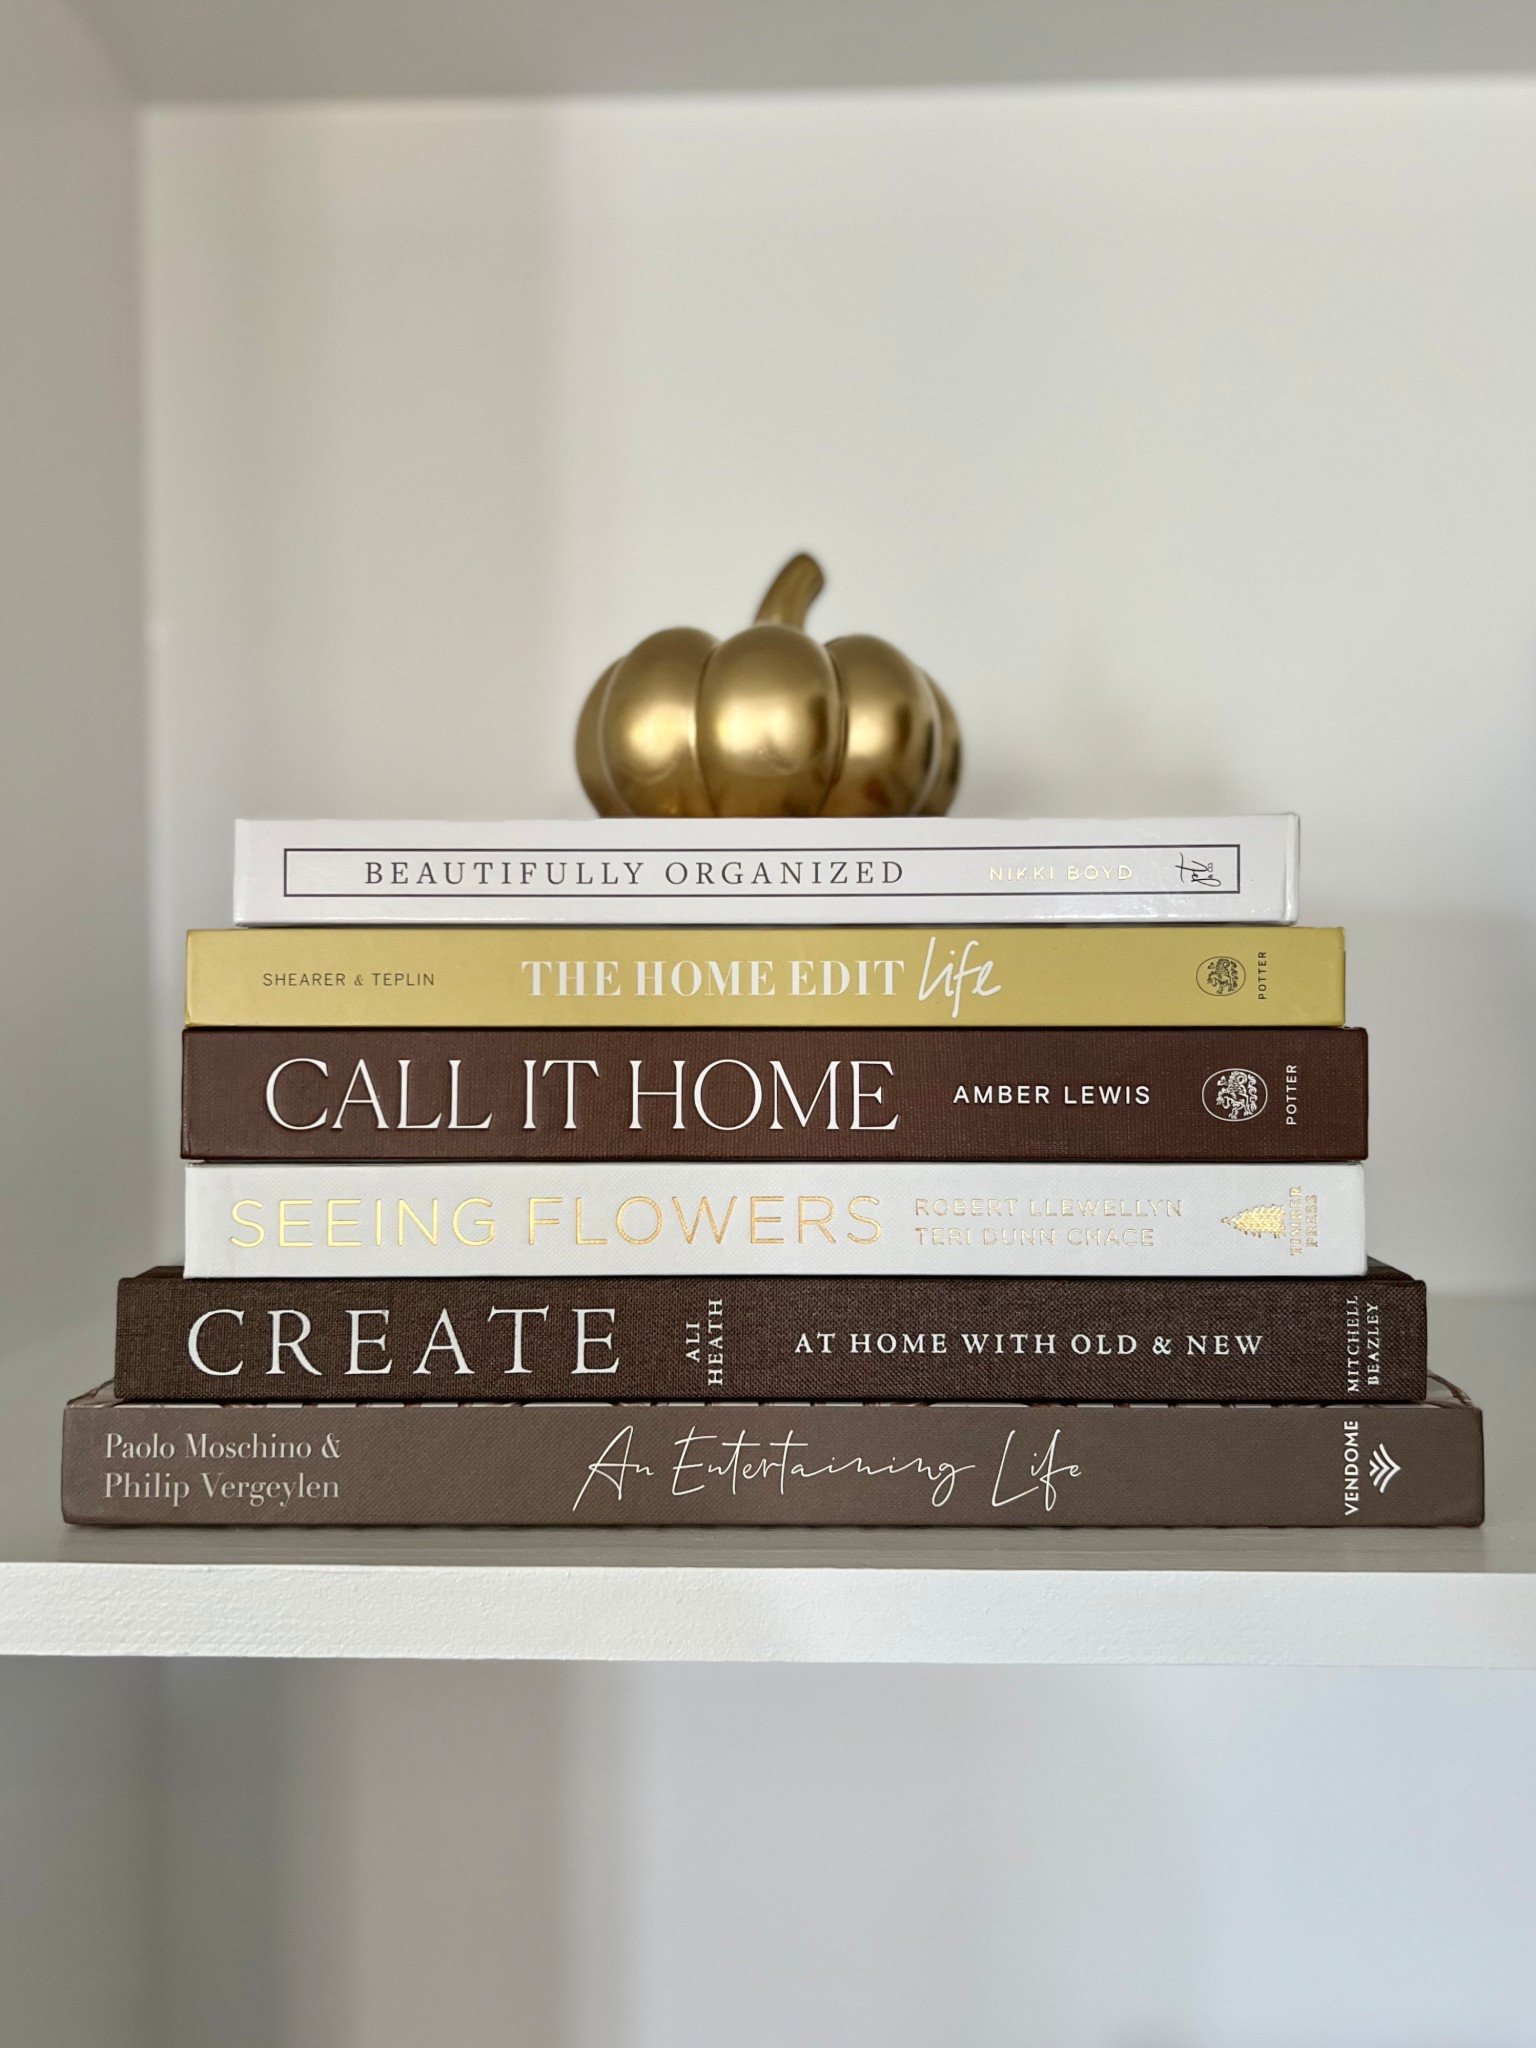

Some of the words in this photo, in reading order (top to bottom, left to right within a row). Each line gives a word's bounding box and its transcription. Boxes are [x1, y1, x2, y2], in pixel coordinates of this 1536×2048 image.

[366, 862, 643, 884] BEAUTIFULLY
[666, 862, 902, 884] ORGANIZED
[989, 866, 1054, 880] NIKKI
[1067, 866, 1131, 880] BOYD
[263, 973, 346, 986] SHEARER
[354, 975, 363, 986] &
[372, 973, 434, 986] TEPLIN
[522, 961, 620, 996] THE
[634, 961, 775, 995] HOME
[788, 961, 904, 995] EDIT
[1258, 952, 1266, 999] POTTER
[267, 1058, 492, 1129] CALL
[524, 1060, 599, 1128] IT
[630, 1059, 898, 1130] HOME
[953, 1086, 1049, 1103] AMBER
[1065, 1086, 1149, 1104] LEWIS
[1286, 1065, 1296, 1124] POTTER
[231, 1197, 494, 1247] SEEING
[528, 1196, 880, 1245] FLOWERS
[916, 1199, 1017, 1216] ROBERT
[1030, 1200, 1181, 1216] LLEWELLYN
[1289, 1187, 1301, 1256] TIMBER
[1306, 1195, 1317, 1247] PRESS
[915, 1228, 971, 1245] TERI
[984, 1228, 1055, 1245] DUNN
[1068, 1229, 1153, 1246] CHACE
[188, 1305, 619, 1375] CREATE
[686, 1322, 700, 1362] ALI
[708, 1299, 723, 1385] HEATH
[795, 1332, 835, 1353] AT
[850, 1334, 946, 1353] HOME
[961, 1334, 1055, 1353] WITH
[1071, 1334, 1136, 1354] OLD
[1153, 1336, 1171, 1354] &
[1187, 1335, 1262, 1354] NEW
[1347, 1296, 1359, 1392] MITCHELL
[1367, 1303, 1380, 1385] BEAZLEY
[107, 1433, 174, 1458] Paolo
[187, 1433, 311, 1458] Moschino
[322, 1433, 340, 1458] &
[573, 1426, 654, 1511] An
[672, 1426, 975, 1507] Entertaining
[992, 1429, 1081, 1511] Life
[1344, 1421, 1358, 1515] VENDOME
[106, 1473, 189, 1506] Philip
[202, 1473, 338, 1506] Vergeylen
